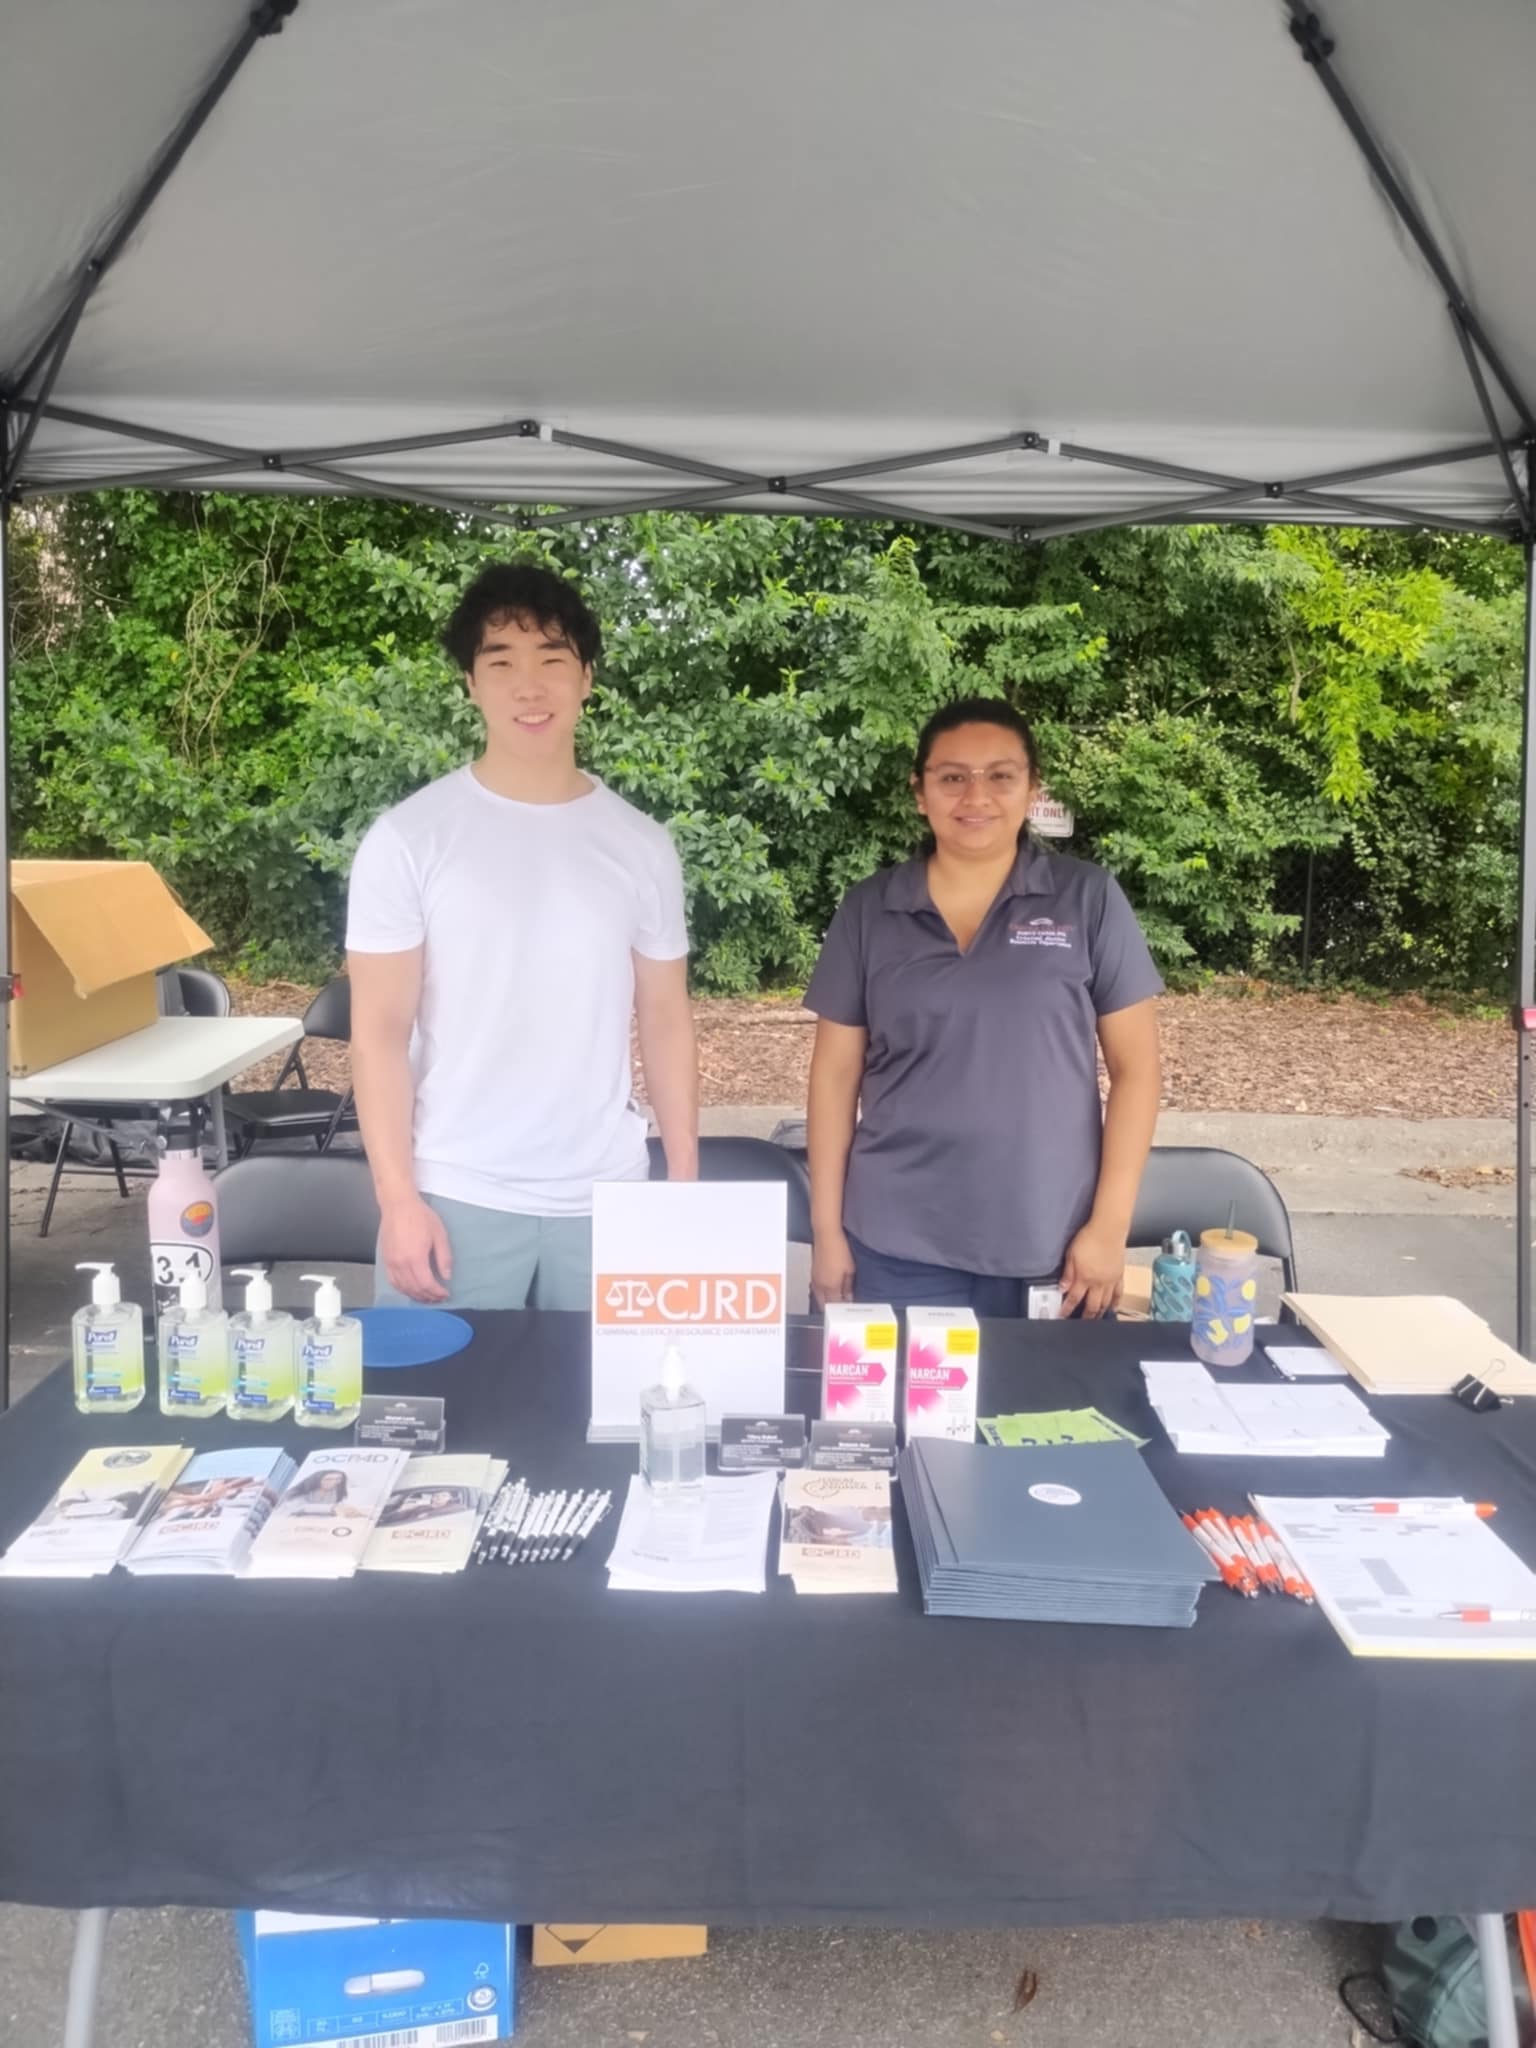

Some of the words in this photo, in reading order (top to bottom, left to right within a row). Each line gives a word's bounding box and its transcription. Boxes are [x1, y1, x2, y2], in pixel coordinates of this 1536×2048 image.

[656, 1279, 778, 1321] CJRD
[828, 1363, 869, 1377] NARCAN
[909, 1367, 950, 1382] NARCAN
